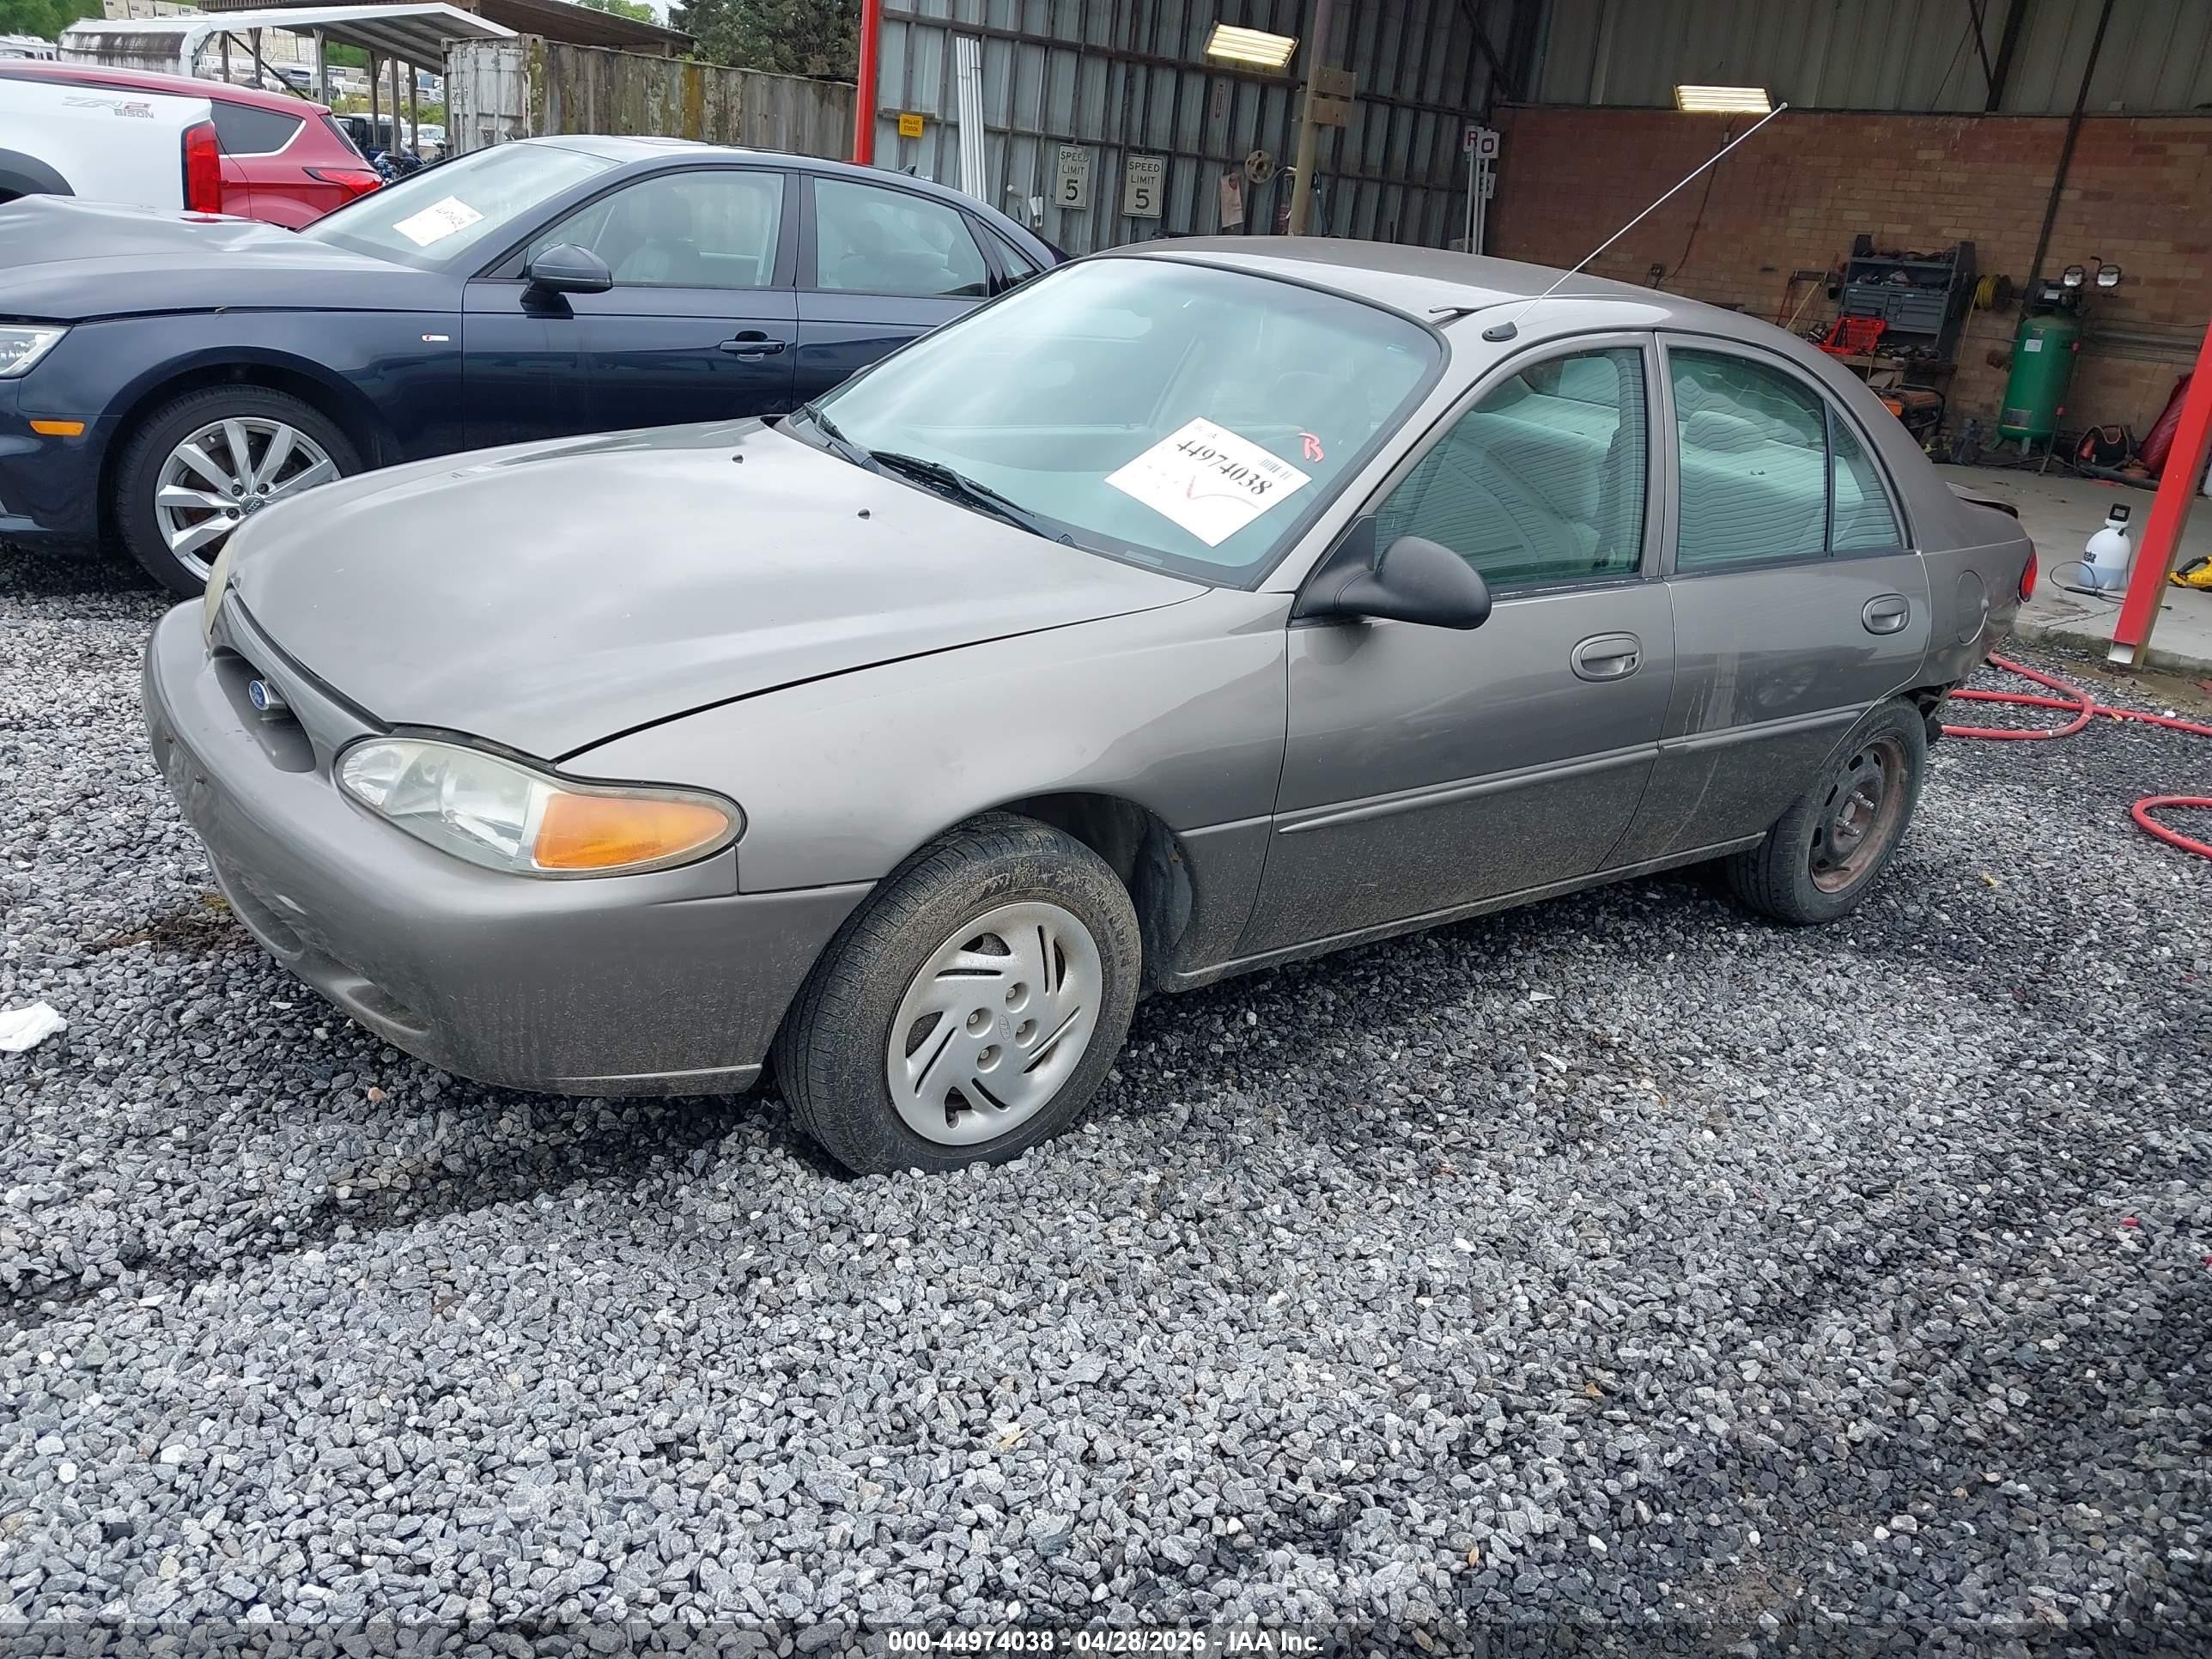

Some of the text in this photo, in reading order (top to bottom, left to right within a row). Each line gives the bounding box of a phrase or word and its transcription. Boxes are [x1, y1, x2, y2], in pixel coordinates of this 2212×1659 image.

[114, 108, 155, 118] BISON
[1060, 150, 1090, 162] SPEED
[1062, 164, 1085, 176] LIMIT
[1128, 161, 1160, 173] SPEED
[1130, 174, 1156, 185] LIMIT
[1065, 178, 1079, 201] 5
[1134, 188, 1150, 210] 5
[1176, 440, 1273, 495] 44974038
